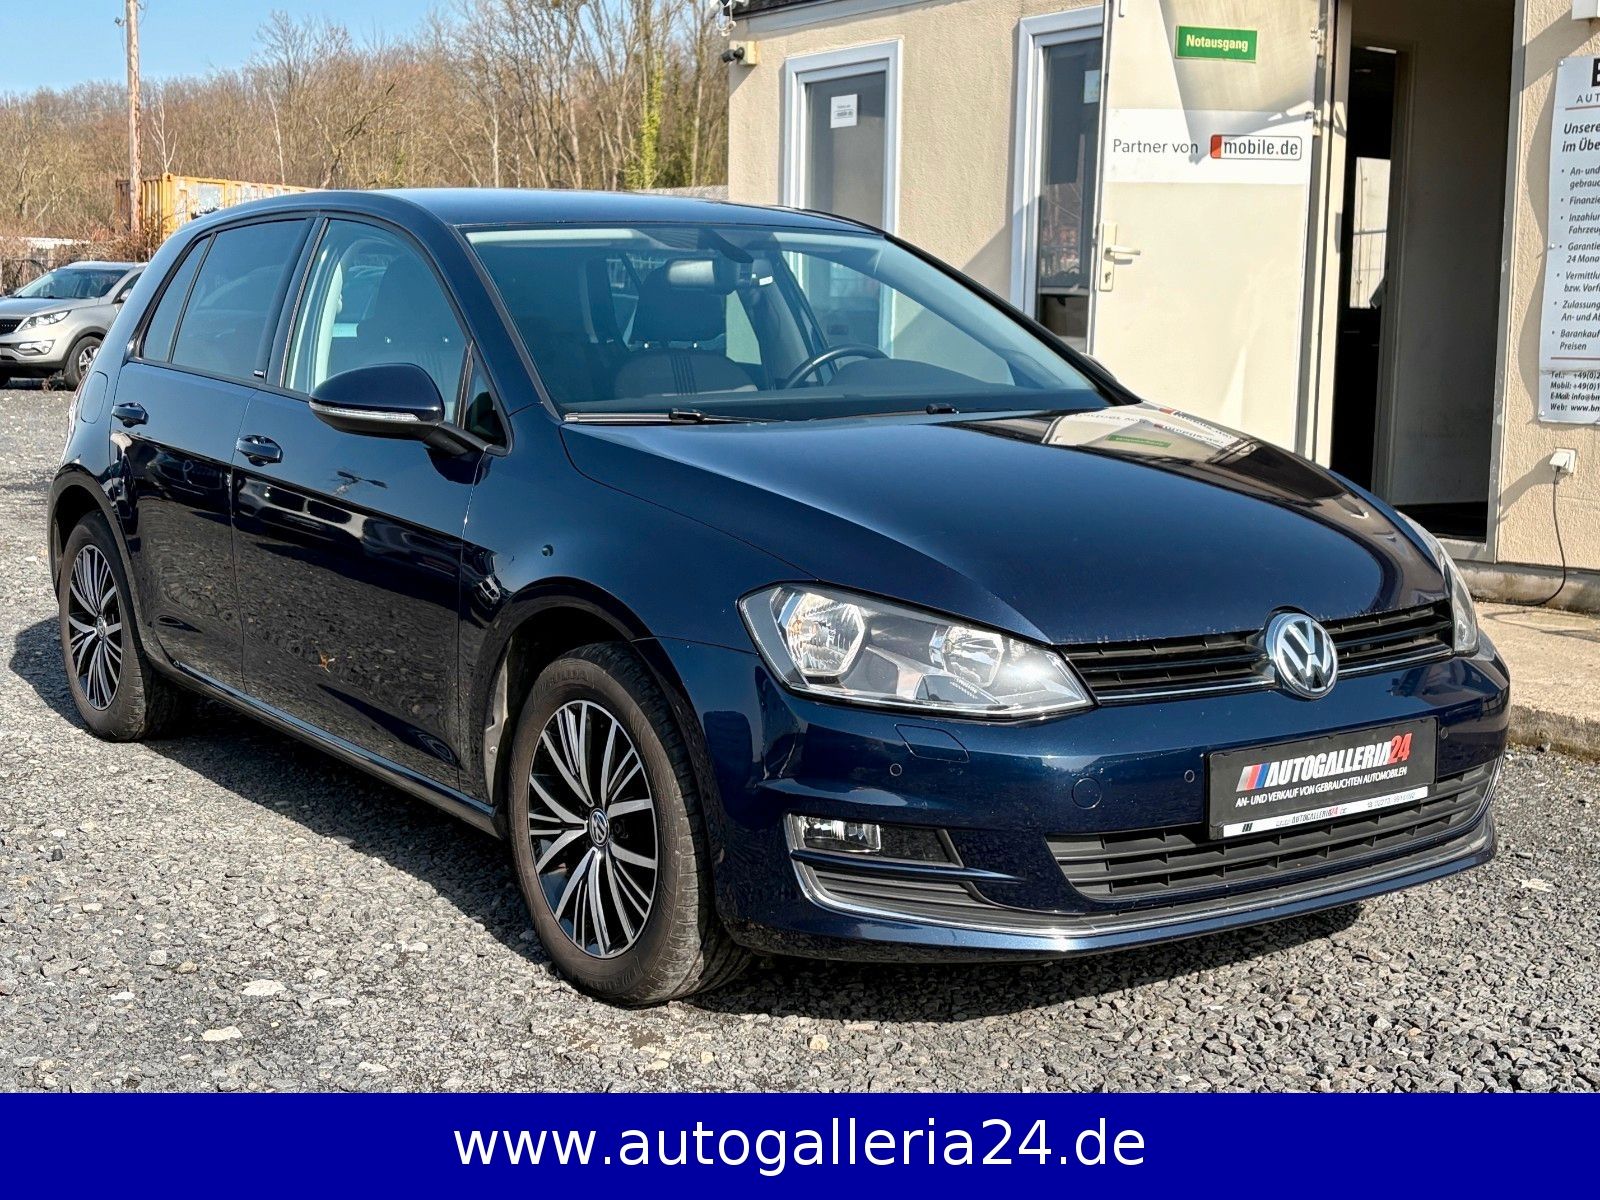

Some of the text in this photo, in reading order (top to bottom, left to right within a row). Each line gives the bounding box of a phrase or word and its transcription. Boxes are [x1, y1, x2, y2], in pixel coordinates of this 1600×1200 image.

[1186, 34, 1249, 52] Notausgang
[1113, 139, 1298, 156] Partner von mobile.de
[1562, 140, 1576, 152] im
[1570, 166, 1584, 176] An-
[1566, 254, 1577, 264] 24
[1564, 283, 1581, 293] bzw.
[1561, 312, 1575, 321] An-
[1576, 312, 1591, 321] und
[1560, 341, 1587, 351] Preisen
[1550, 381, 1572, 390] Mobil:
[1550, 402, 1568, 411] Web:
[1264, 732, 1413, 788] AUTOGALLERIA24
[1235, 766, 1408, 808] AN- UND VERKAUF VON GEBRAUCHTEN AUTOMOBILEN
